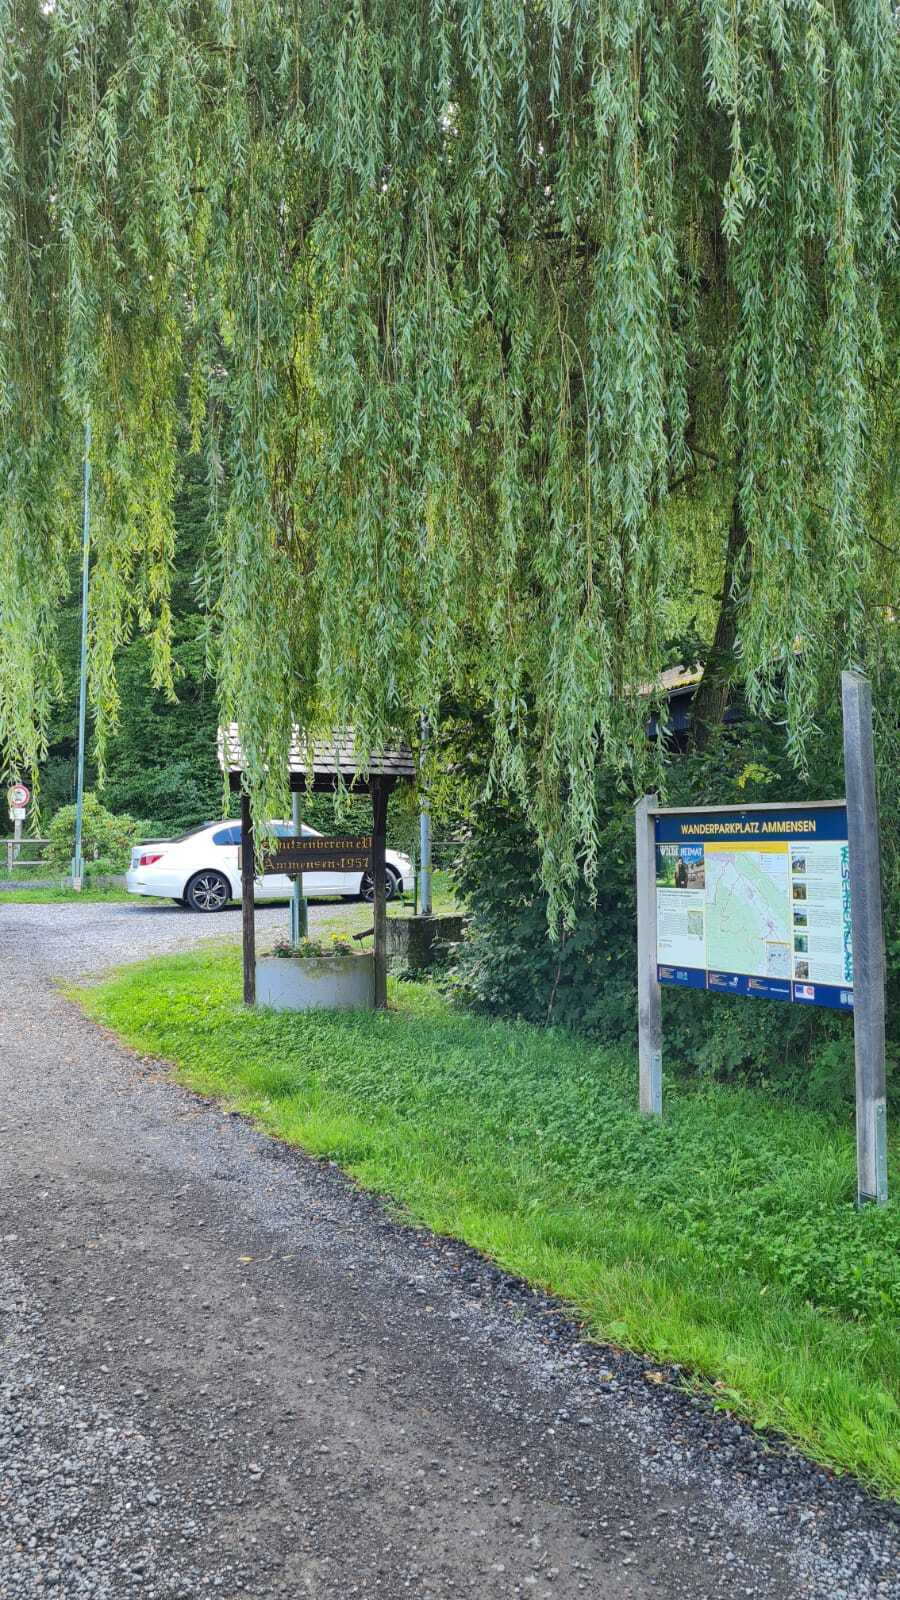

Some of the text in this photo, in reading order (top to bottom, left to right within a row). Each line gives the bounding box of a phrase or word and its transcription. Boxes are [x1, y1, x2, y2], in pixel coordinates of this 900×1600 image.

[681, 820, 817, 835] WANDERPARKPLATZ AMMENSEN
[680, 847, 703, 857] HEIMAT
